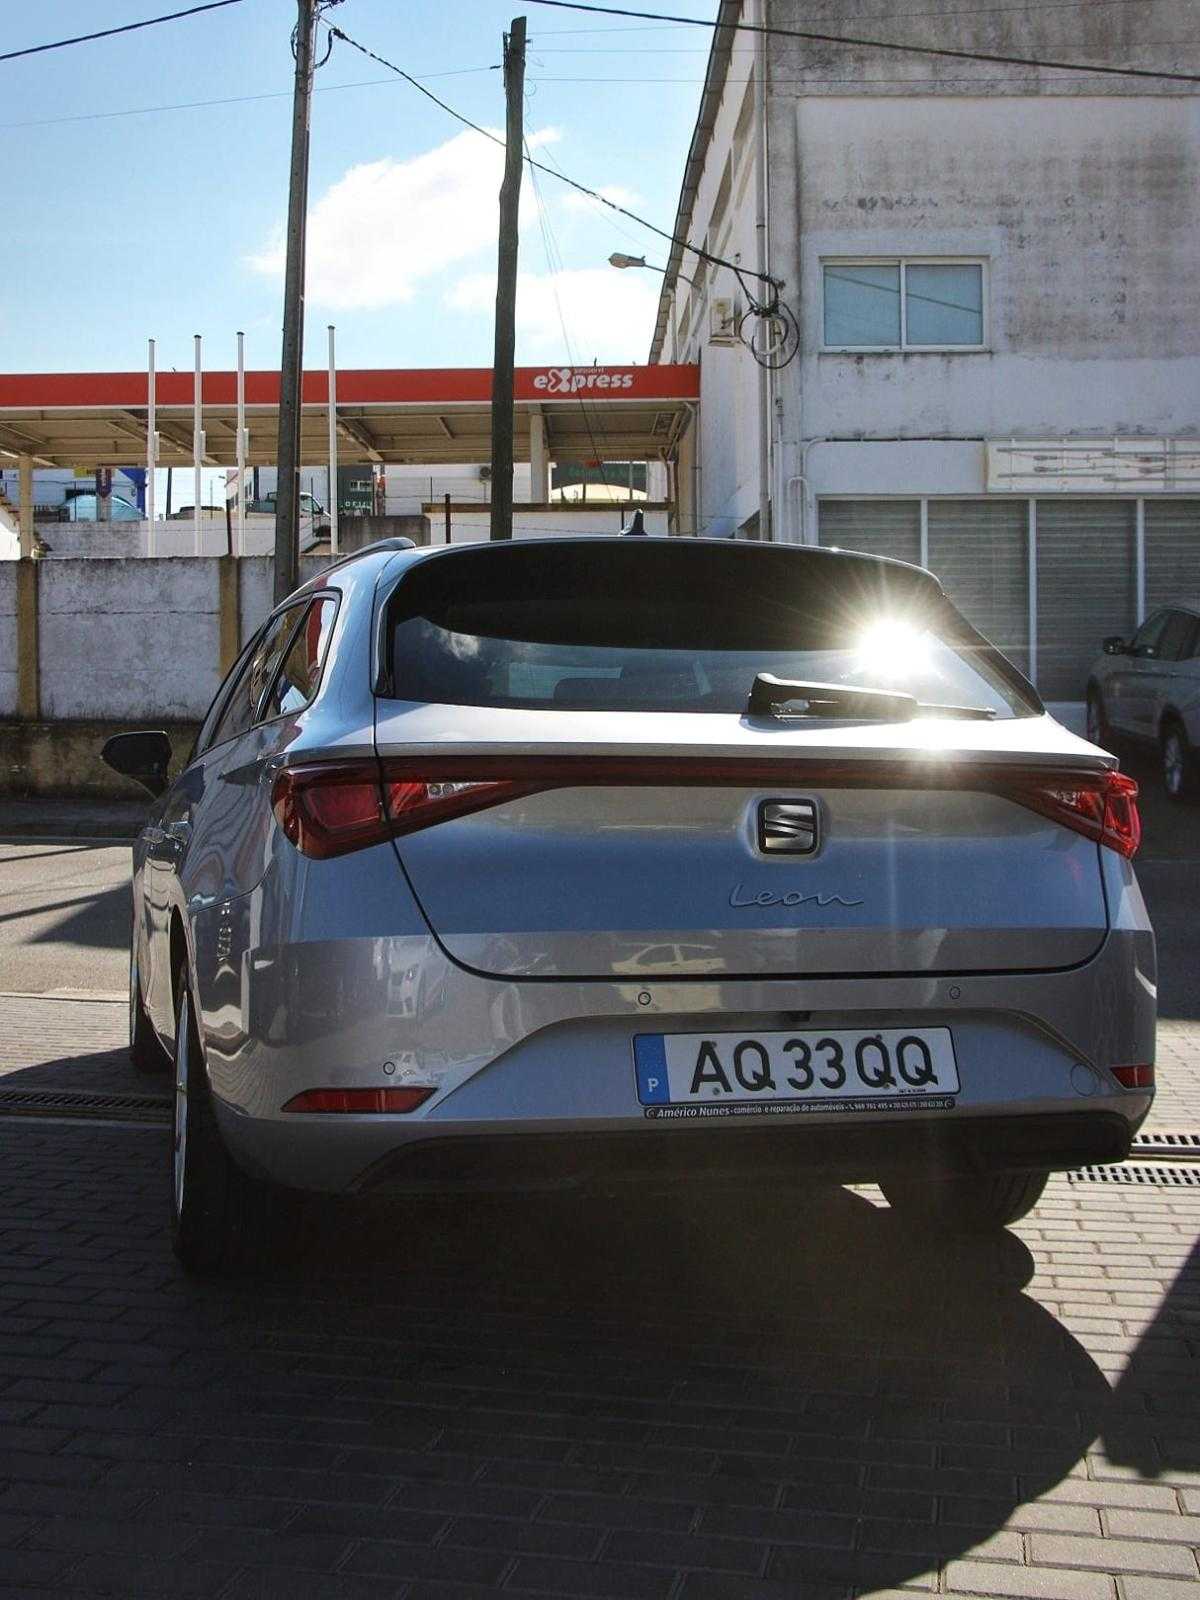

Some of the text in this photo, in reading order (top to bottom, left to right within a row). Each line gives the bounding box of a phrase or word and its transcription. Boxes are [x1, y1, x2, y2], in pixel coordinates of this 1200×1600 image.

[728, 883, 865, 909] Leon
[647, 1077, 659, 1093] P
[656, 1106, 697, 1118] Américo
[699, 1105, 731, 1117] Nunes
